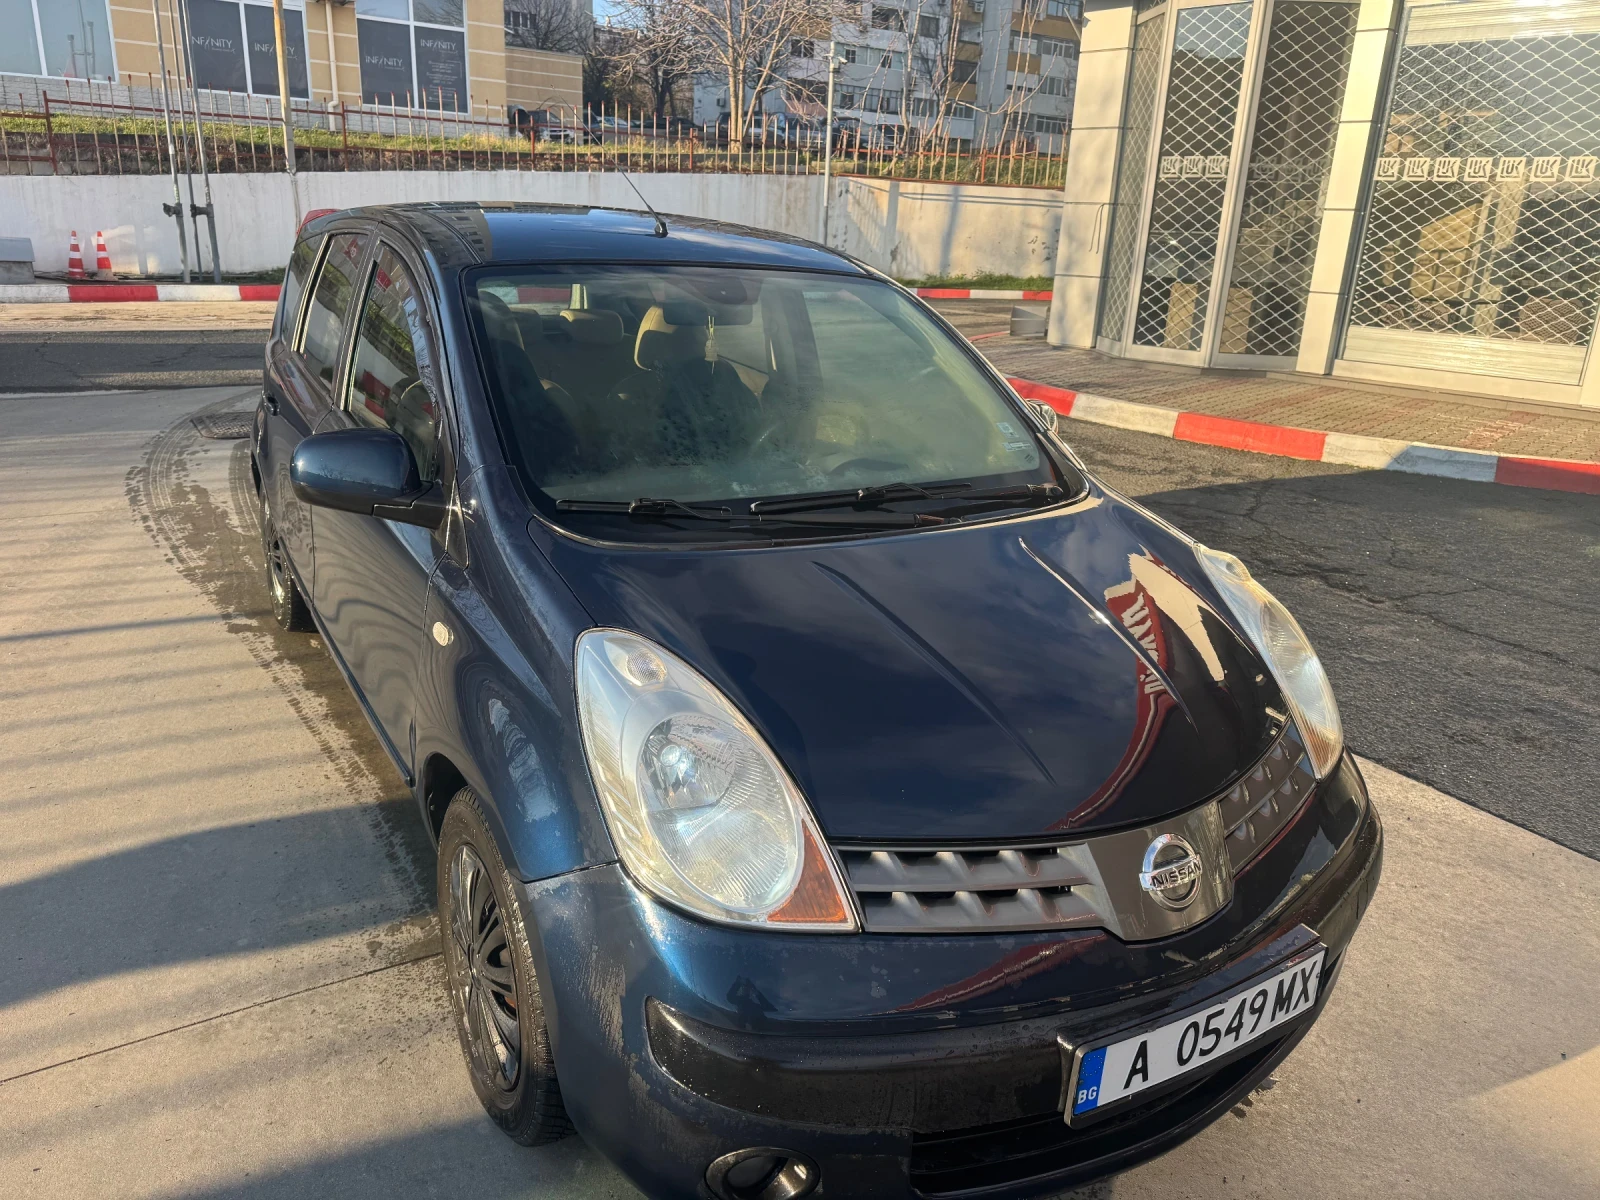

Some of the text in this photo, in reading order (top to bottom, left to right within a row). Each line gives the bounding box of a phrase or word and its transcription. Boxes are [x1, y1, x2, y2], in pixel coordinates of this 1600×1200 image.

[191, 36, 232, 49] NFINITY
[420, 39, 457, 51] INFINITY
[365, 55, 403, 67] INFINITY
[1151, 861, 1201, 887] NISSAN
[1123, 960, 1317, 1090] A 0549 MX
[1077, 1086, 1097, 1105] BG
